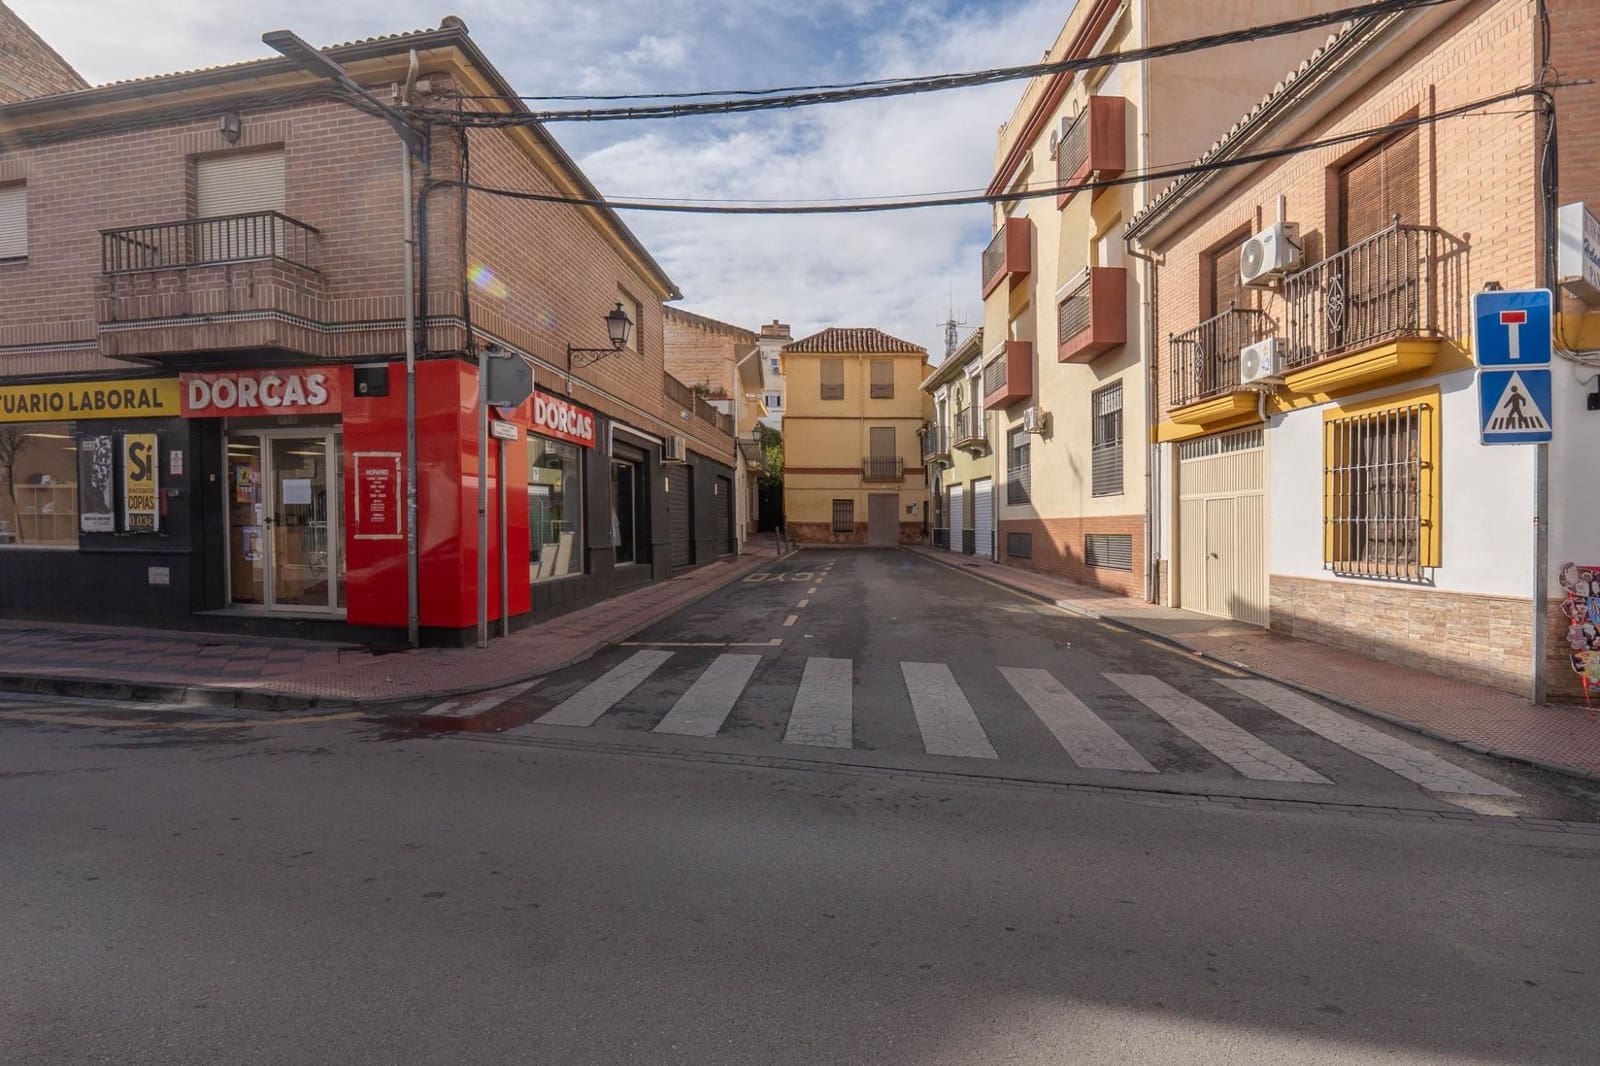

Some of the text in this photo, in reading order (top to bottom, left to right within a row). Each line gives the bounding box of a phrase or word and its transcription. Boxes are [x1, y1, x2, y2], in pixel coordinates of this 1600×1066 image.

[0, 387, 164, 414] UARIO LABORAL
[189, 373, 328, 409] DORCAS
[534, 396, 592, 440] DORCAS
[129, 442, 152, 481] Sí
[128, 495, 154, 510] COPIAS
